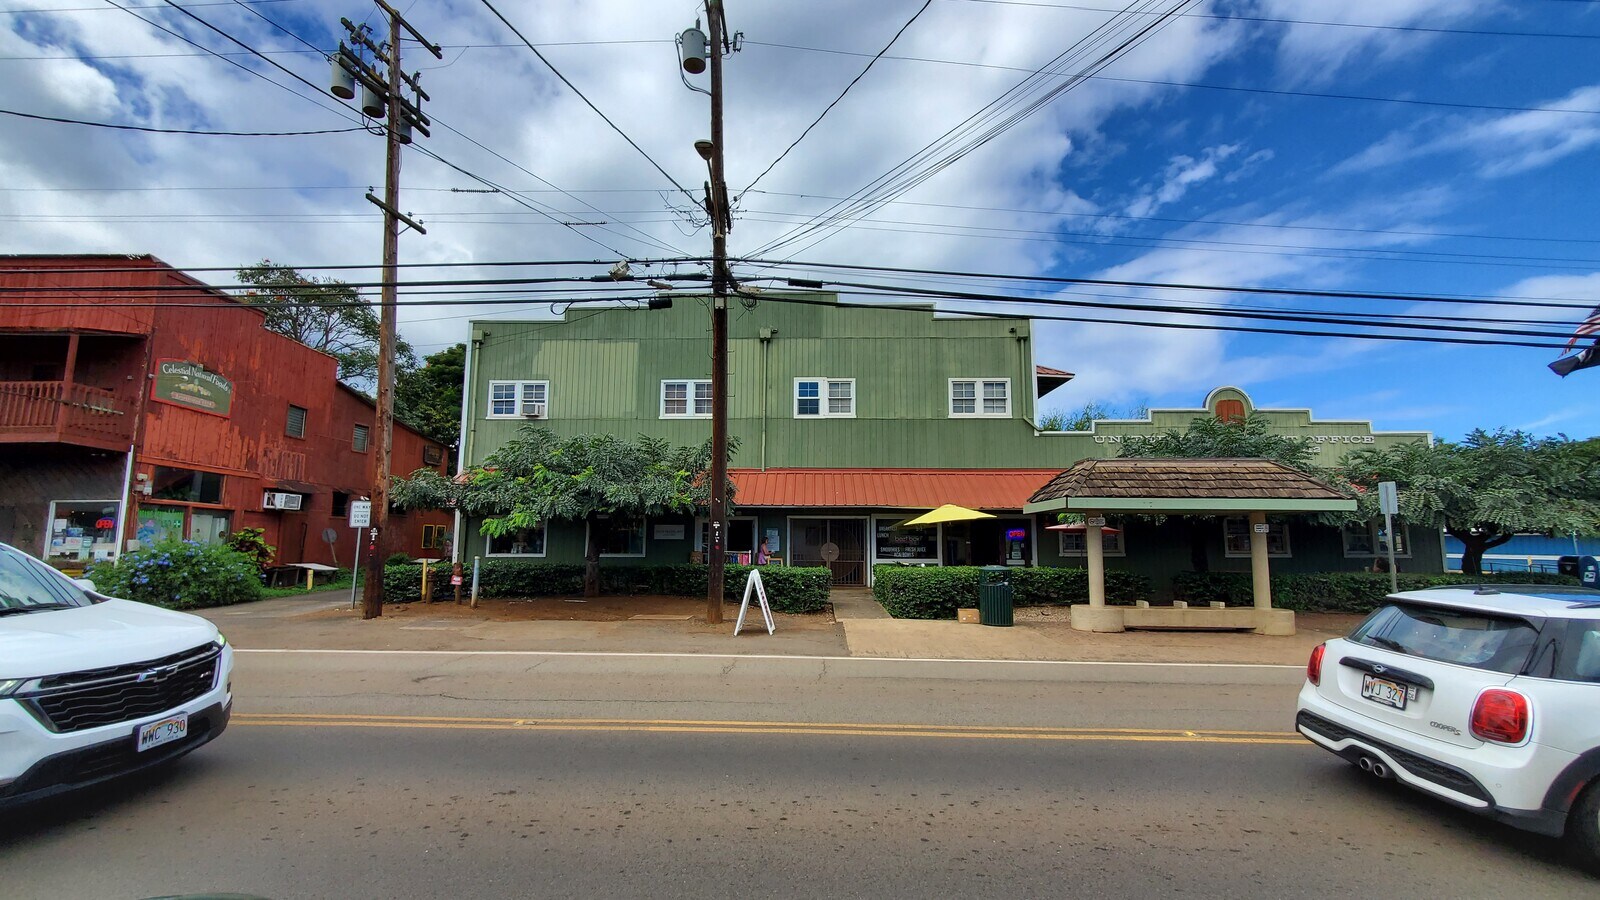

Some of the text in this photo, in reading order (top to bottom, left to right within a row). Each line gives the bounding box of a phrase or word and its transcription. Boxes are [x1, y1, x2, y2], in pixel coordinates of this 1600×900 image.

[162, 363, 230, 392] Celestial Natural Foods
[95, 519, 114, 529] OPEN
[1364, 679, 1382, 696] WVJ
[1386, 686, 1404, 703] 327
[141, 726, 161, 745] WWC
[167, 719, 186, 736] 930
